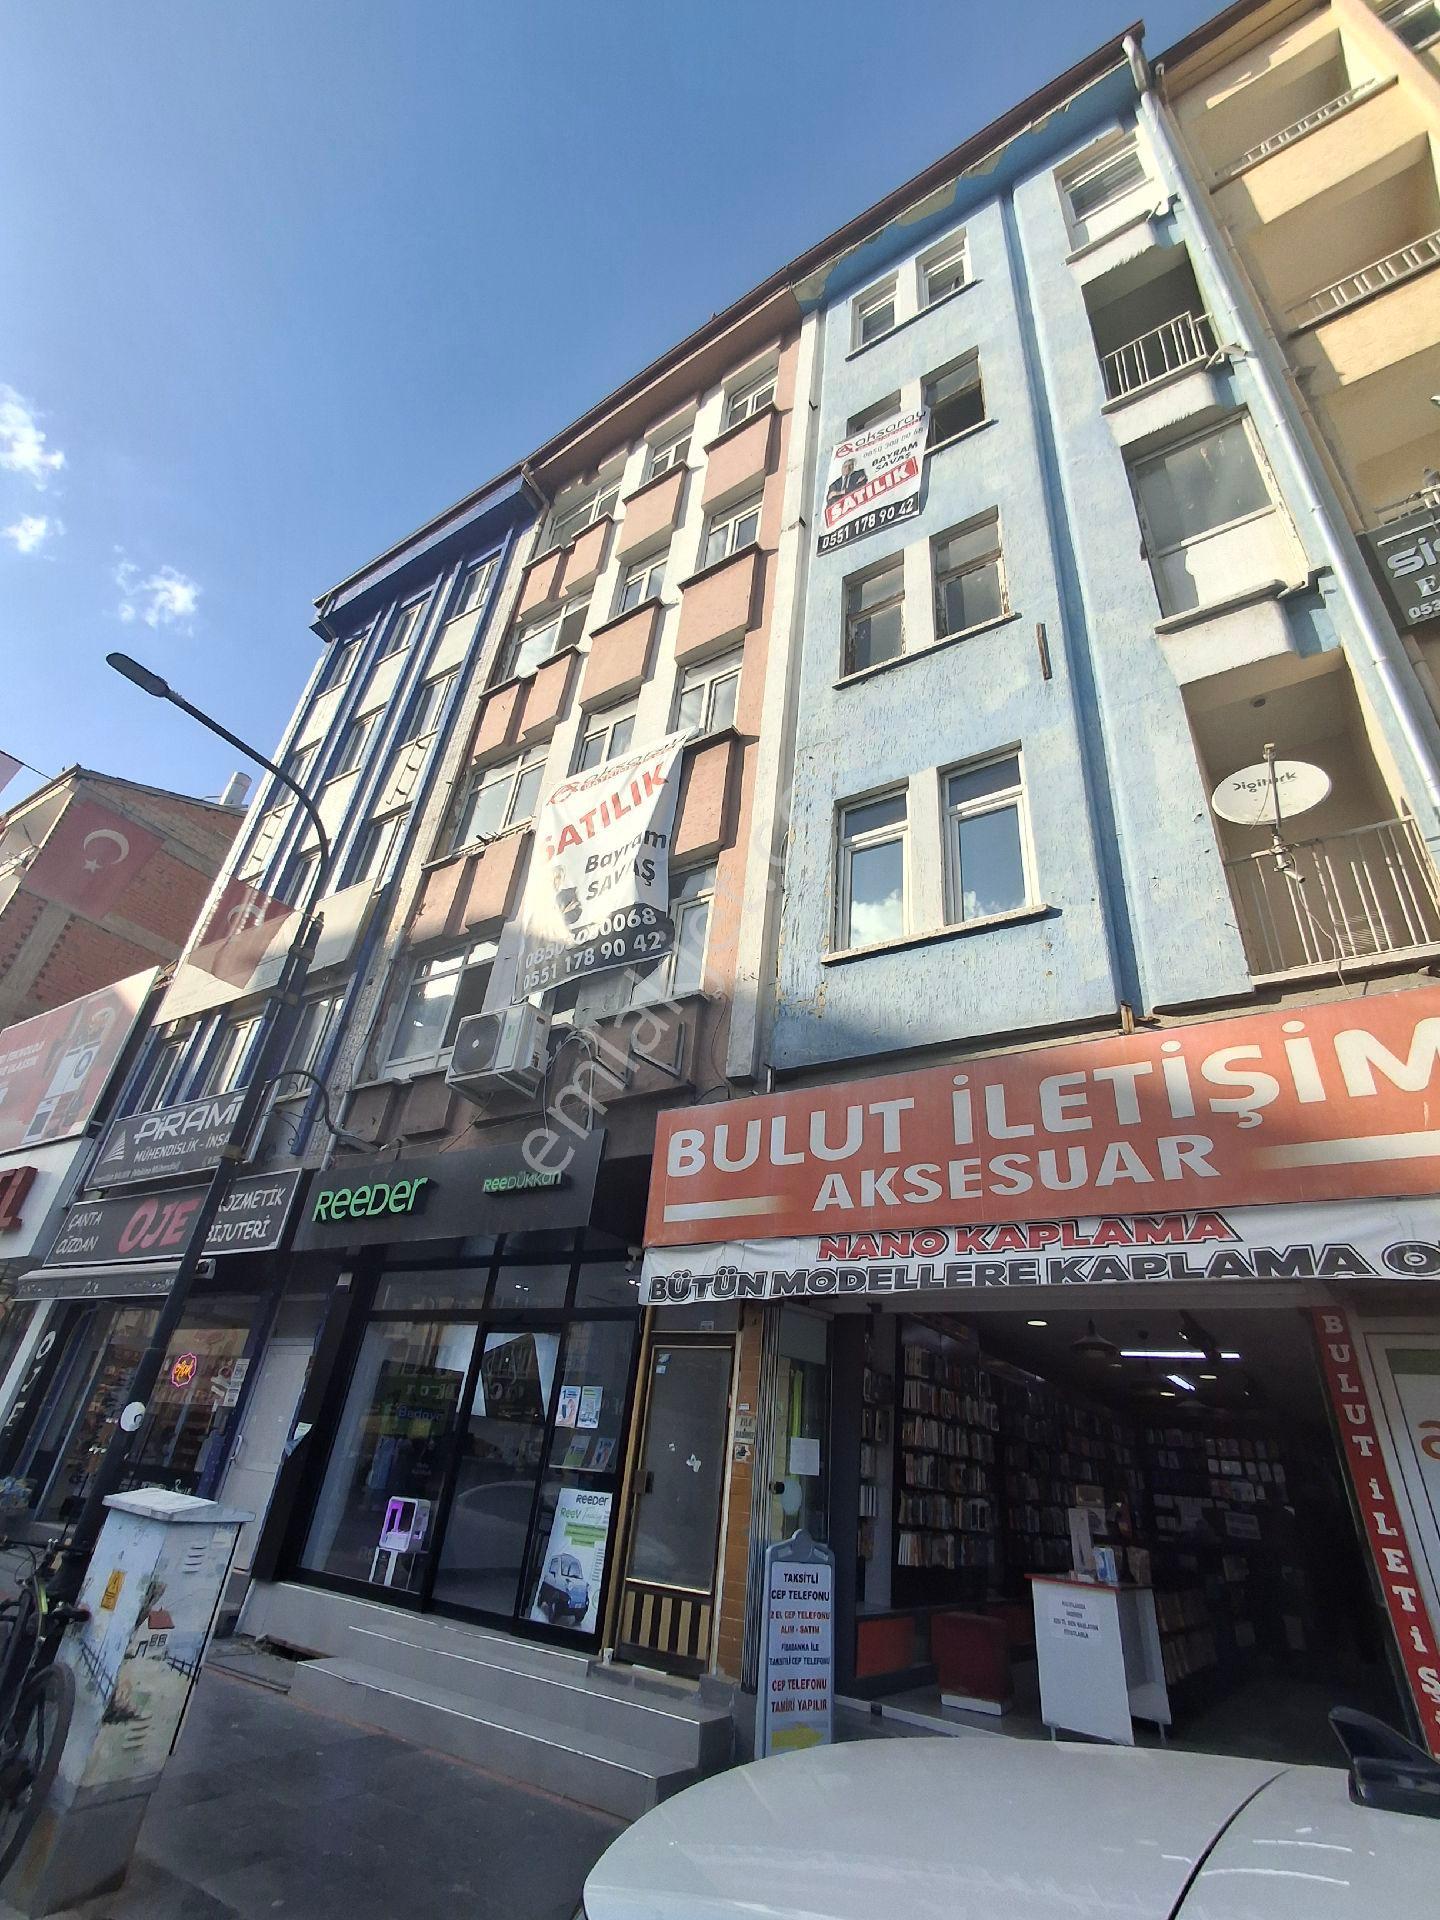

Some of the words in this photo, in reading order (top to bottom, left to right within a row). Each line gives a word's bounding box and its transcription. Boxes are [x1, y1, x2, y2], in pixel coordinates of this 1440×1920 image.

[871, 441, 918, 467] BAYRAM
[830, 463, 911, 520] SATILIK
[822, 527, 849, 549] 0551
[854, 514, 875, 535] 178
[879, 509, 894, 527] 90
[899, 498, 914, 515] 42
[585, 829, 667, 874] Bayram
[523, 963, 557, 991] 0551
[565, 947, 595, 973] 178
[600, 938, 626, 960] 90
[633, 931, 662, 952] 42
[666, 1097, 915, 1178] BULUT
[952, 1016, 1440, 1146] İLETİŞİM
[133, 1136, 199, 1163] MÜHENDİSLİK
[812, 1134, 1221, 1212] AKSESUAR
[68, 1211, 102, 1232] ÇANTA
[118, 1199, 202, 1254] OJE
[816, 1228, 949, 1262] NANO
[953, 1211, 1243, 1257] KAPLAMA
[650, 1265, 768, 1302] BÜTÜN
[769, 1256, 1042, 1296] MODELLERE
[1046, 1243, 1382, 1284] KAPLAMA
[1321, 1315, 1375, 1457] BULUT
[771, 1589, 787, 1600] CEP
[788, 1590, 830, 1601] TELEFONU
[783, 1572, 819, 1584] TAKSİTLİ
[784, 1611, 796, 1620] CEP
[797, 1611, 830, 1620] TELEFONU
[799, 1625, 819, 1634] SATIM
[772, 1680, 785, 1692] CEP
[787, 1679, 827, 1690] TELEFONU
[798, 1698, 827, 1711] YAPILIR
